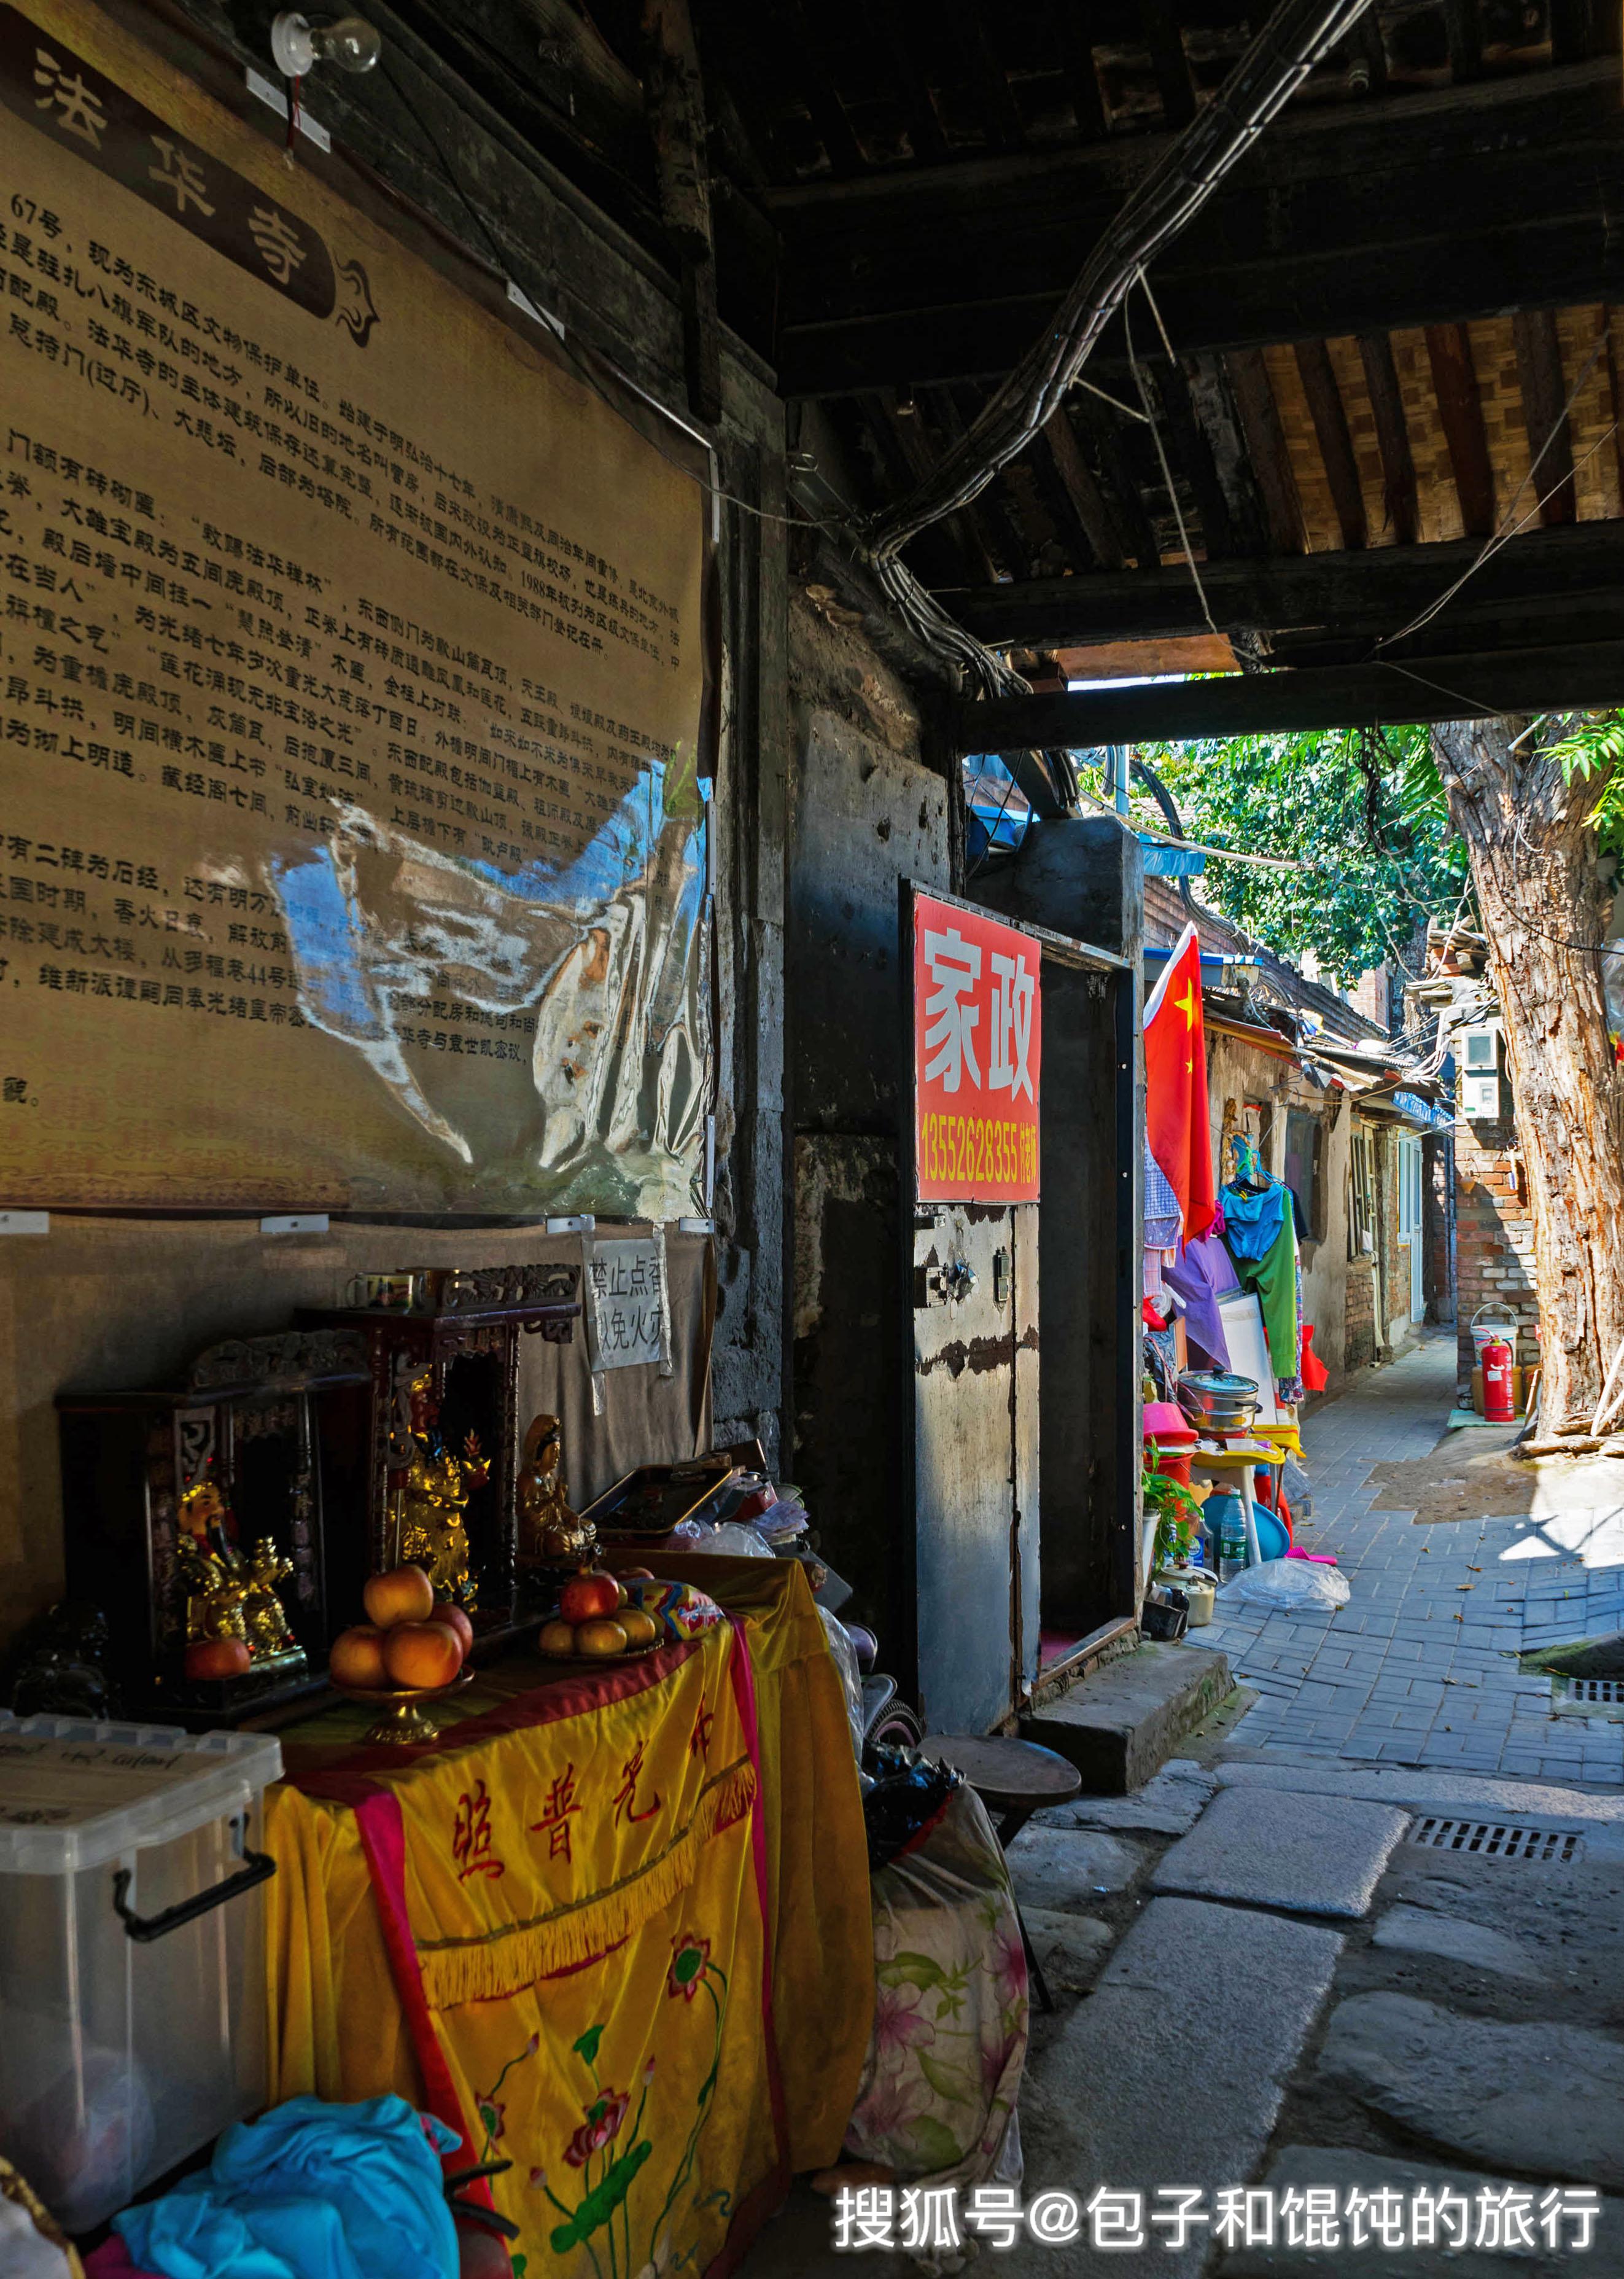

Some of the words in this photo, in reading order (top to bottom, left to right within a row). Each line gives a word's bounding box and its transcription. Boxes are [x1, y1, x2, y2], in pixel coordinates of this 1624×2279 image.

[33, 47, 308, 286] 法华寺
[924, 927, 1035, 1105] 家政
[922, 1112, 1018, 1183] 13552628355
